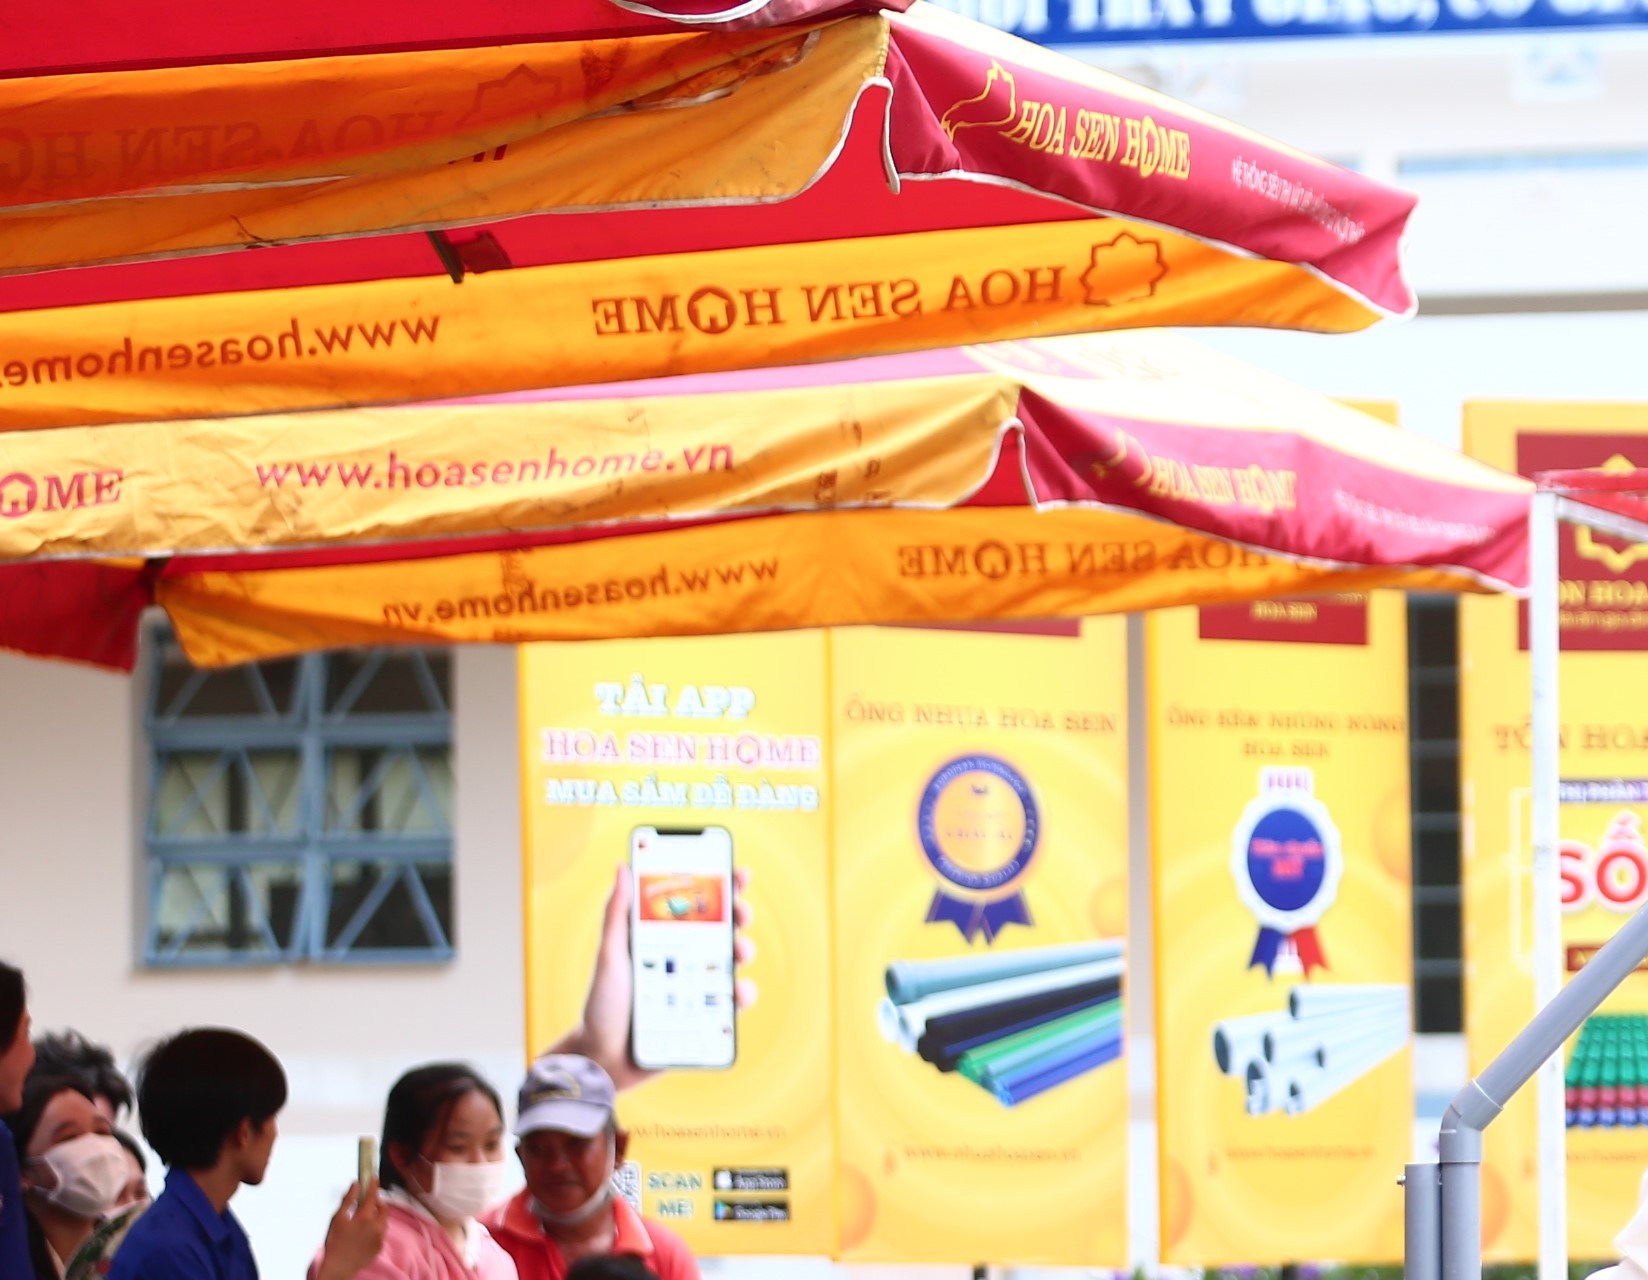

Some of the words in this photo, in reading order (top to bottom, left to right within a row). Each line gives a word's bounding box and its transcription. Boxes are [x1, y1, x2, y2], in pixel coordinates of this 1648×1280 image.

[1017, 99, 1067, 155] HOA
[1069, 108, 1120, 162] SEN
[1121, 115, 1191, 180] HOME
[256, 444, 735, 490] www.hoasenhome.vn
[594, 673, 670, 717] TẢI
[673, 684, 756, 719] APP
[543, 729, 621, 763] HOA
[627, 732, 698, 764] SEN
[705, 734, 820, 767] HOME
[547, 778, 619, 806] MUA
[648, 1171, 703, 1191] SCAN
